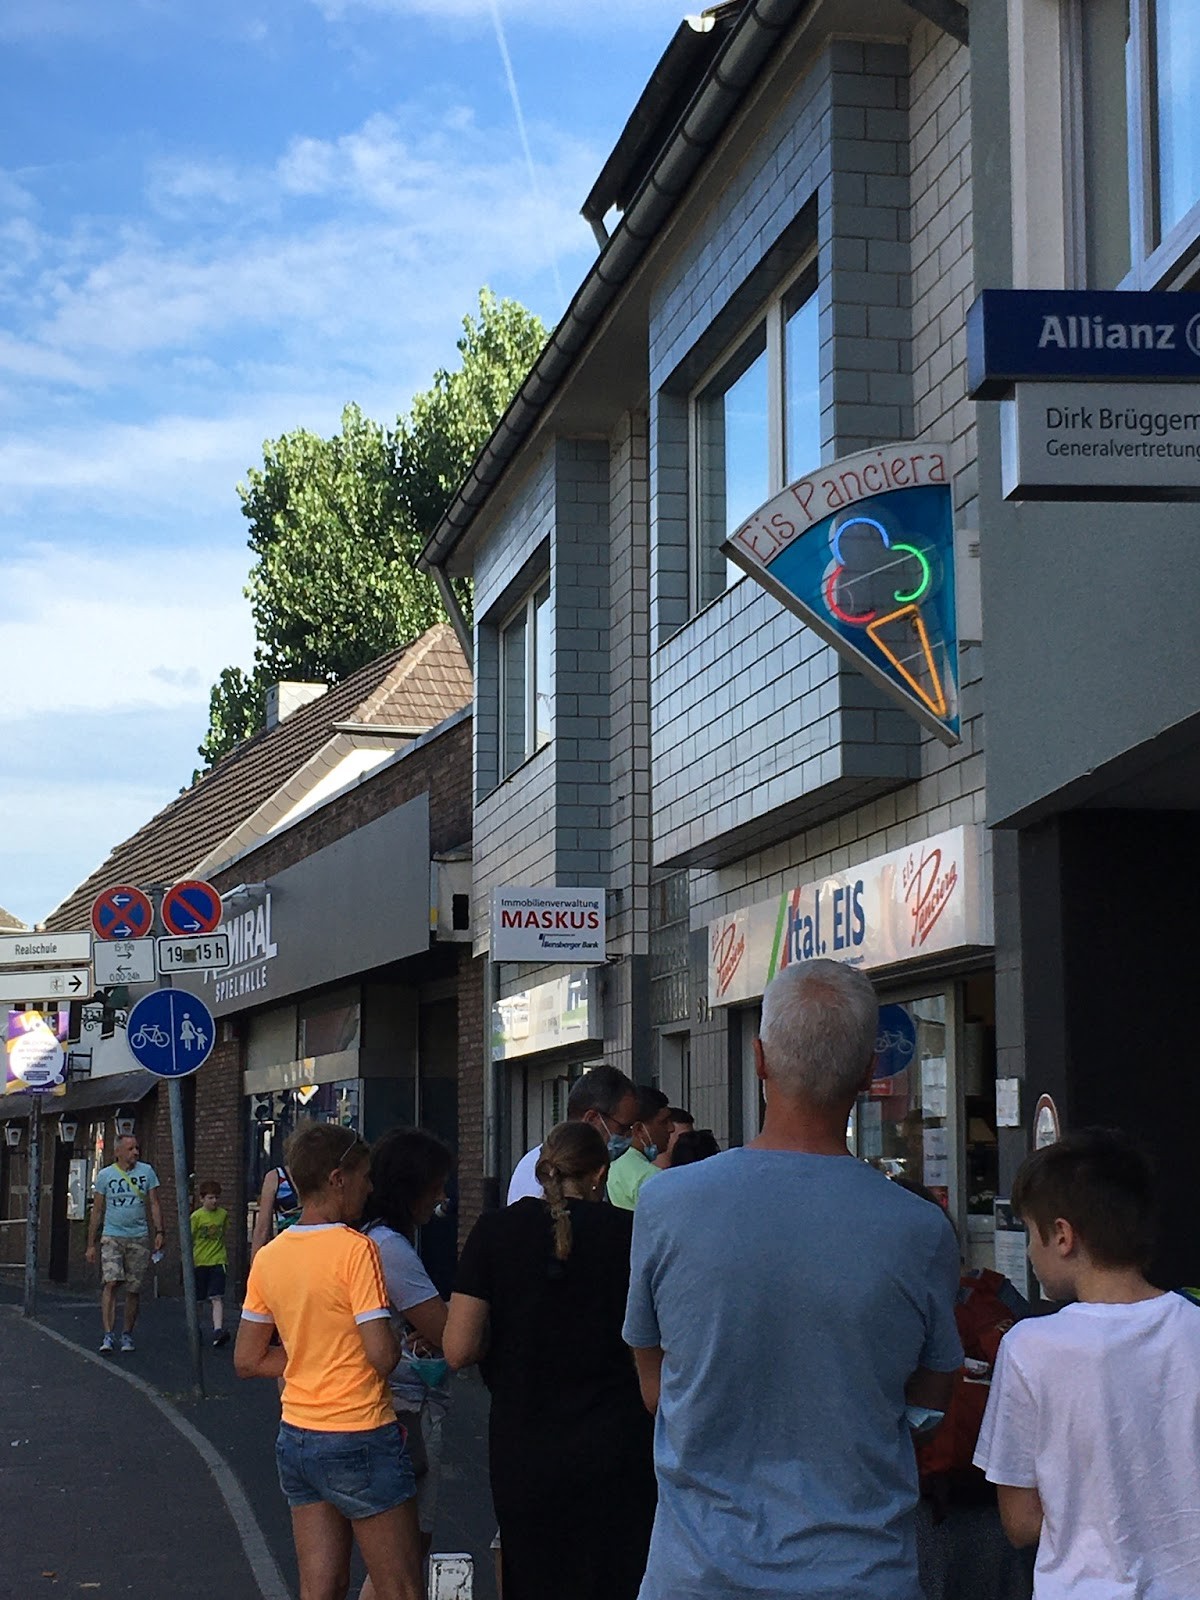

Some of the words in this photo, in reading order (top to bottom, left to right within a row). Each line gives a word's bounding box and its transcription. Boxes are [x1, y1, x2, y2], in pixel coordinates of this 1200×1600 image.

[1038, 315, 1176, 350] Allianz
[1046, 407, 1093, 430] Dirk
[737, 513, 796, 563] Eis
[791, 452, 946, 521] Panciera
[501, 898, 599, 909] Immobilienverwaltung
[501, 910, 599, 929] MASKUS
[788, 889, 826, 963] Ital.
[833, 880, 865, 951] EIS
[15, 943, 57, 955] Realschule
[204, 893, 278, 985] MIRAL
[216, 942, 223, 959] h
[216, 966, 266, 1003] SPIELHALLE
